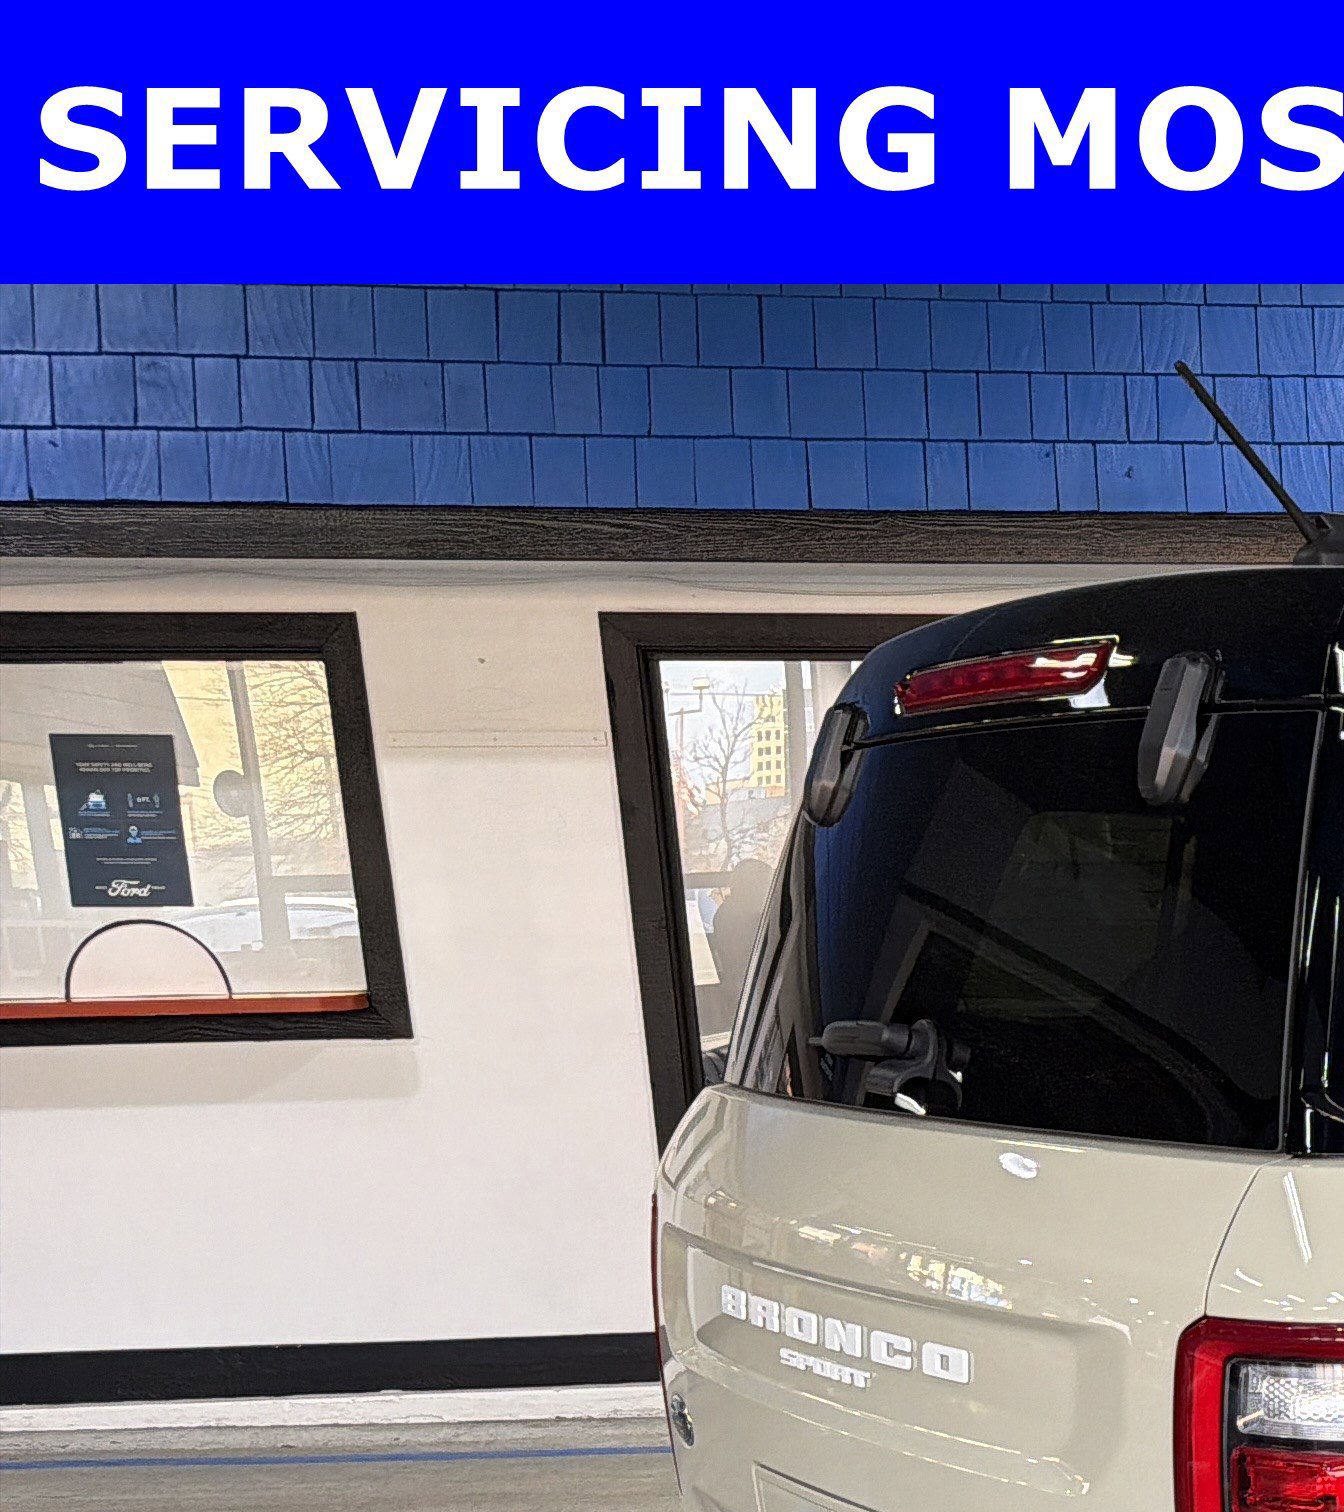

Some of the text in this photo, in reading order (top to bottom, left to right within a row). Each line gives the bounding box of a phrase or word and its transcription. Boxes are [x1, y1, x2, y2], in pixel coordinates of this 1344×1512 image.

[107, 880, 151, 897] Ford
[721, 1284, 974, 1385] BRONCO
[779, 1347, 875, 1389] SPORT
